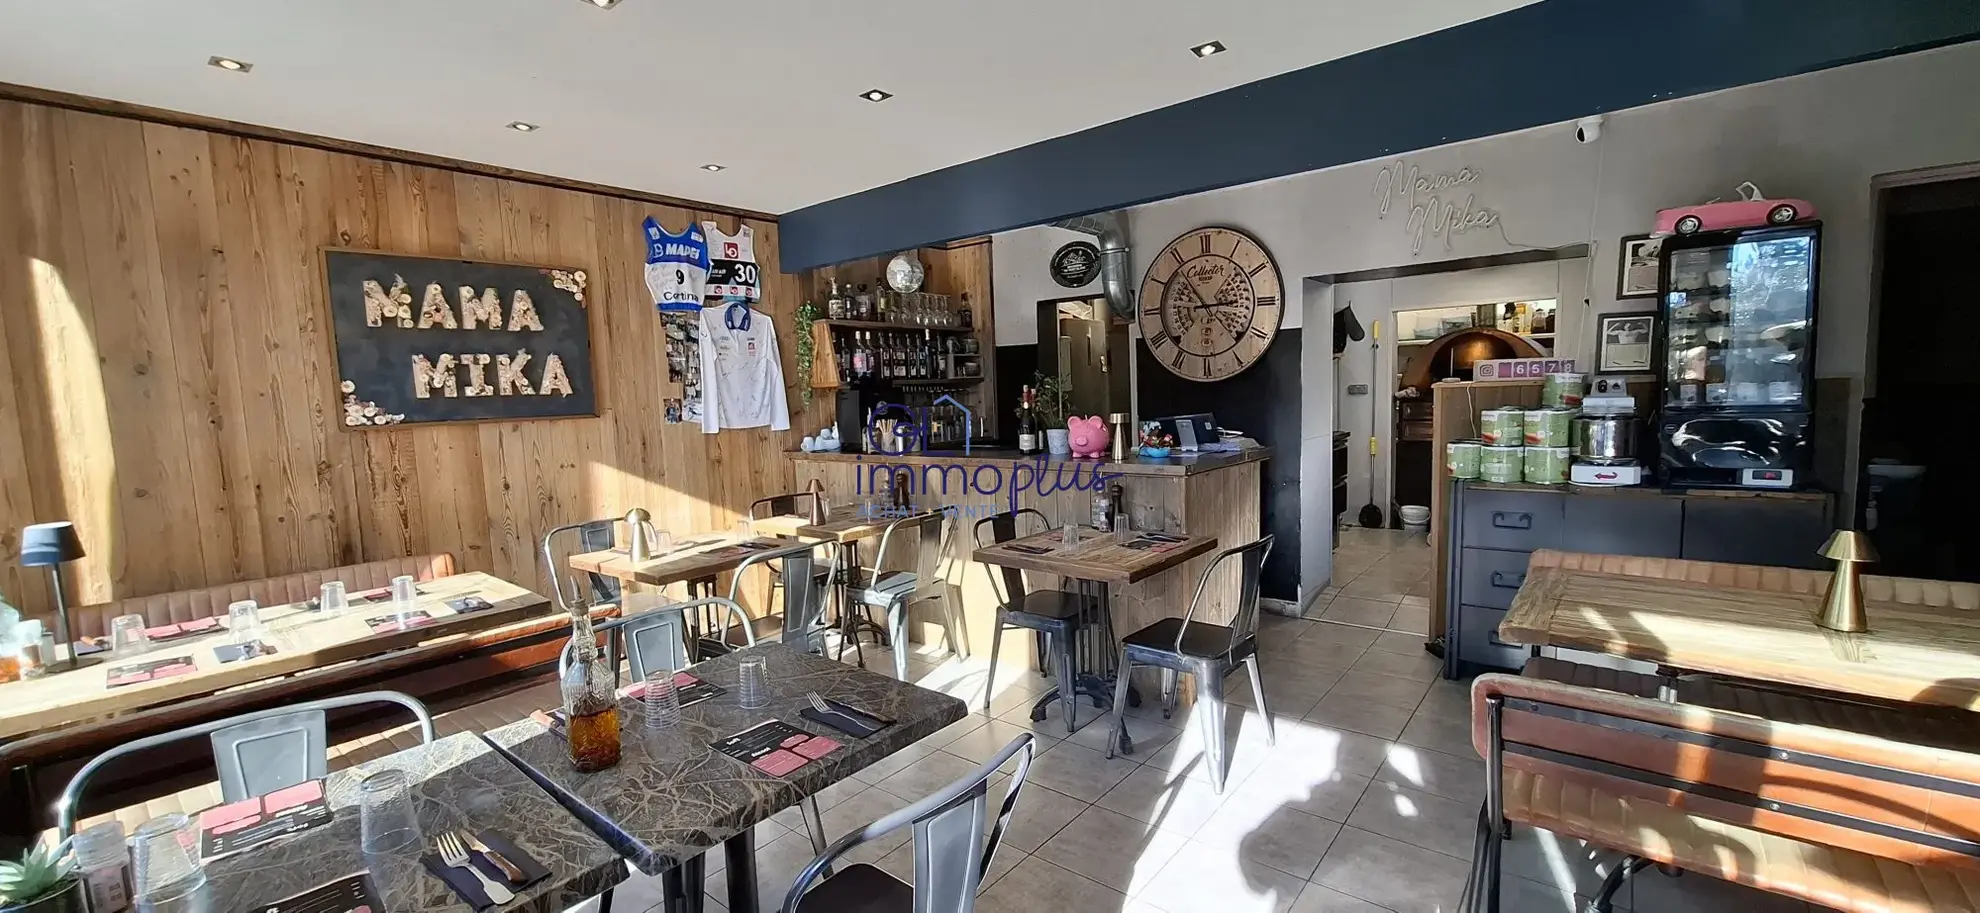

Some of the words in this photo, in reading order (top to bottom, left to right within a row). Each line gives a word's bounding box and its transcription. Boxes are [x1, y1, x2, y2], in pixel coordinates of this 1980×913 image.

[1373, 160, 1481, 214] Mama
[1407, 194, 1498, 252] Mika
[665, 243, 700, 260] MAPEI
[675, 269, 685, 285] 9
[734, 263, 756, 284] 30
[1187, 264, 1224, 279] Collector
[362, 278, 545, 332] MAMA
[412, 353, 573, 399] MIKA
